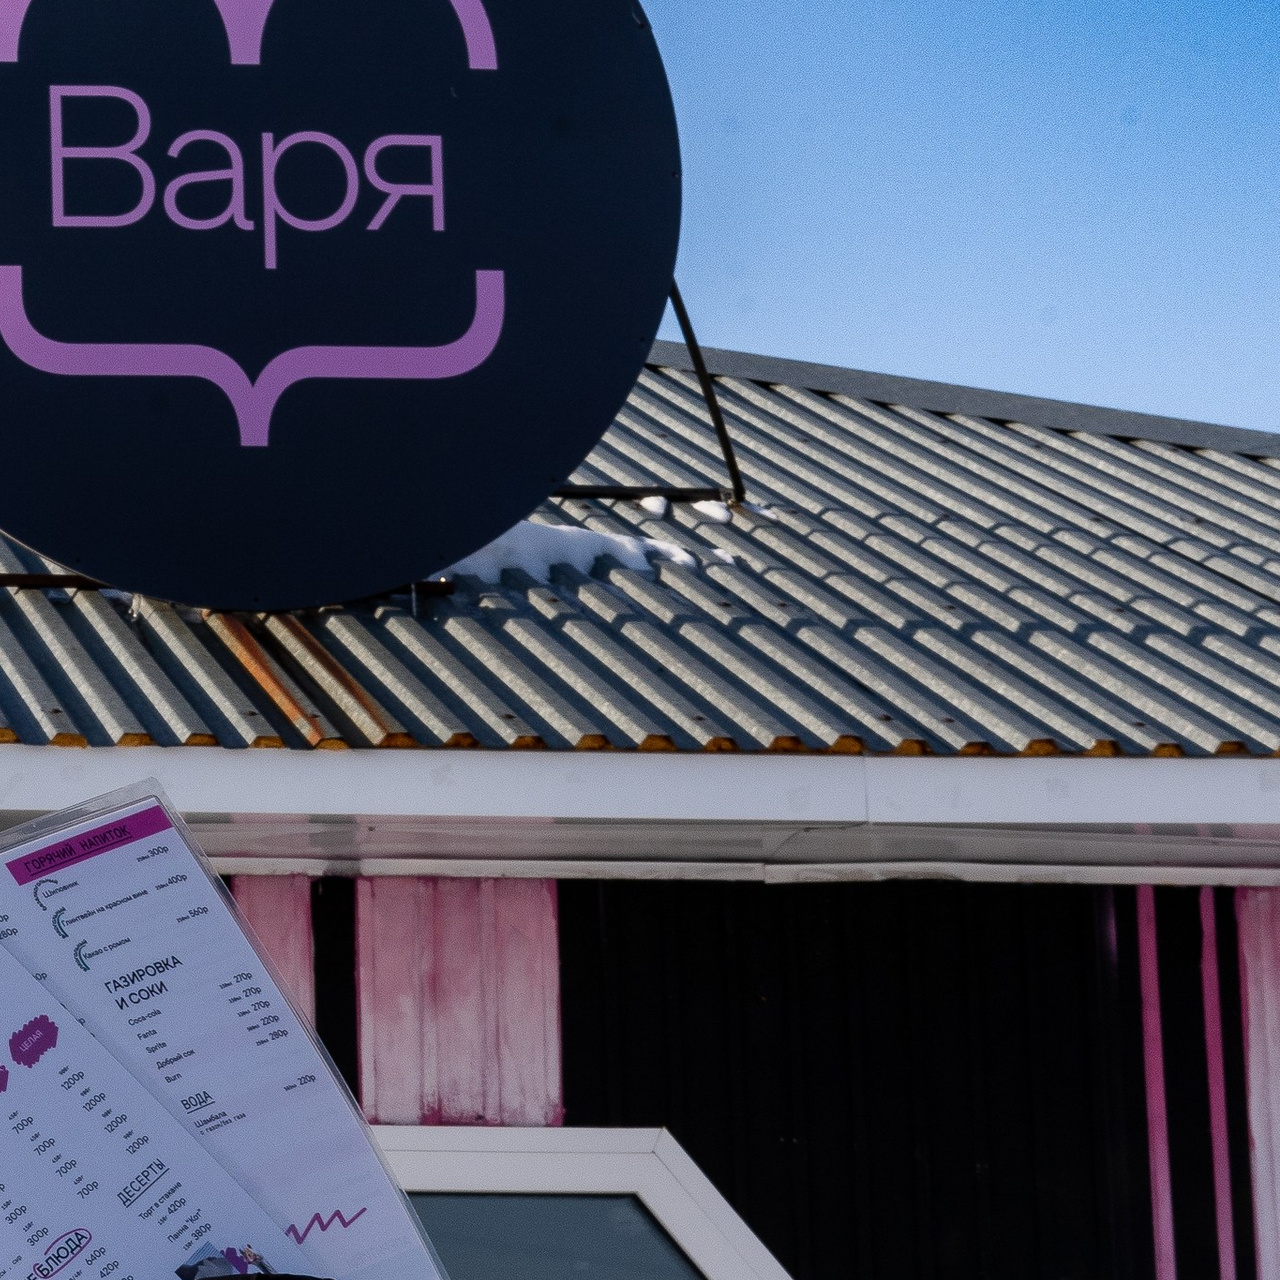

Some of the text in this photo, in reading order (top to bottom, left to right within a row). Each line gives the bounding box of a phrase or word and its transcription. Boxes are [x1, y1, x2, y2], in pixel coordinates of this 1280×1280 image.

[48, 84, 447, 271] Варя
[23, 823, 130, 873] ГОРЯЧИЙ НАПИТОК
[147, 845, 169, 858] 300р
[167, 874, 188, 885] 400р
[41, 880, 79, 899] Шиповник
[60, 909, 97, 927] Глинтвейн
[104, 895, 133, 910] красном
[131, 889, 149, 899] вине
[187, 906, 209, 918] 560р
[82, 948, 104, 960] Какао
[107, 937, 131, 951] ромом
[104, 955, 183, 994] ГАЗИРОВКА
[232, 972, 253, 984] 270р
[114, 980, 169, 1010] И СОКИ
[242, 986, 262, 998] 270р
[250, 1000, 271, 1012] 270р
[127, 1009, 162, 1026] Coca-cola
[259, 1014, 280, 1026] 220р
[18, 1028, 44, 1052] ЦЕЛАЯ
[136, 1029, 158, 1041] Fanta
[268, 1029, 289, 1041] 280р
[145, 1041, 167, 1054] Sprite
[155, 1049, 196, 1070] Добрый сок
[60, 1070, 85, 1091] 1200р
[164, 1073, 182, 1084] Burn
[297, 1074, 316, 1086] 220р
[82, 1092, 106, 1112] 1200р
[180, 1090, 214, 1113] ВОДА
[11, 1116, 34, 1135] 700р
[103, 1113, 128, 1134] 1200р
[193, 1111, 228, 1129] Шамбала
[33, 1137, 56, 1156] 700р
[125, 1135, 149, 1155] 1200р
[54, 1159, 77, 1178] 700р
[76, 1180, 99, 1200] 700р
[116, 1158, 169, 1208] ДЕСЕРТЫ
[137, 1205, 155, 1220] Торт
[158, 1181, 182, 1204] стакане
[167, 1197, 187, 1215] 420р
[4, 1204, 27, 1225] 300р
[166, 1208, 201, 1243] Панна "Кот"
[190, 1222, 212, 1241] 380р
[26, 1226, 49, 1247] 300р
[36, 1227, 91, 1280] БЛЮДА
[84, 1246, 106, 1266] 640р
[99, 1260, 120, 1279] 420р
